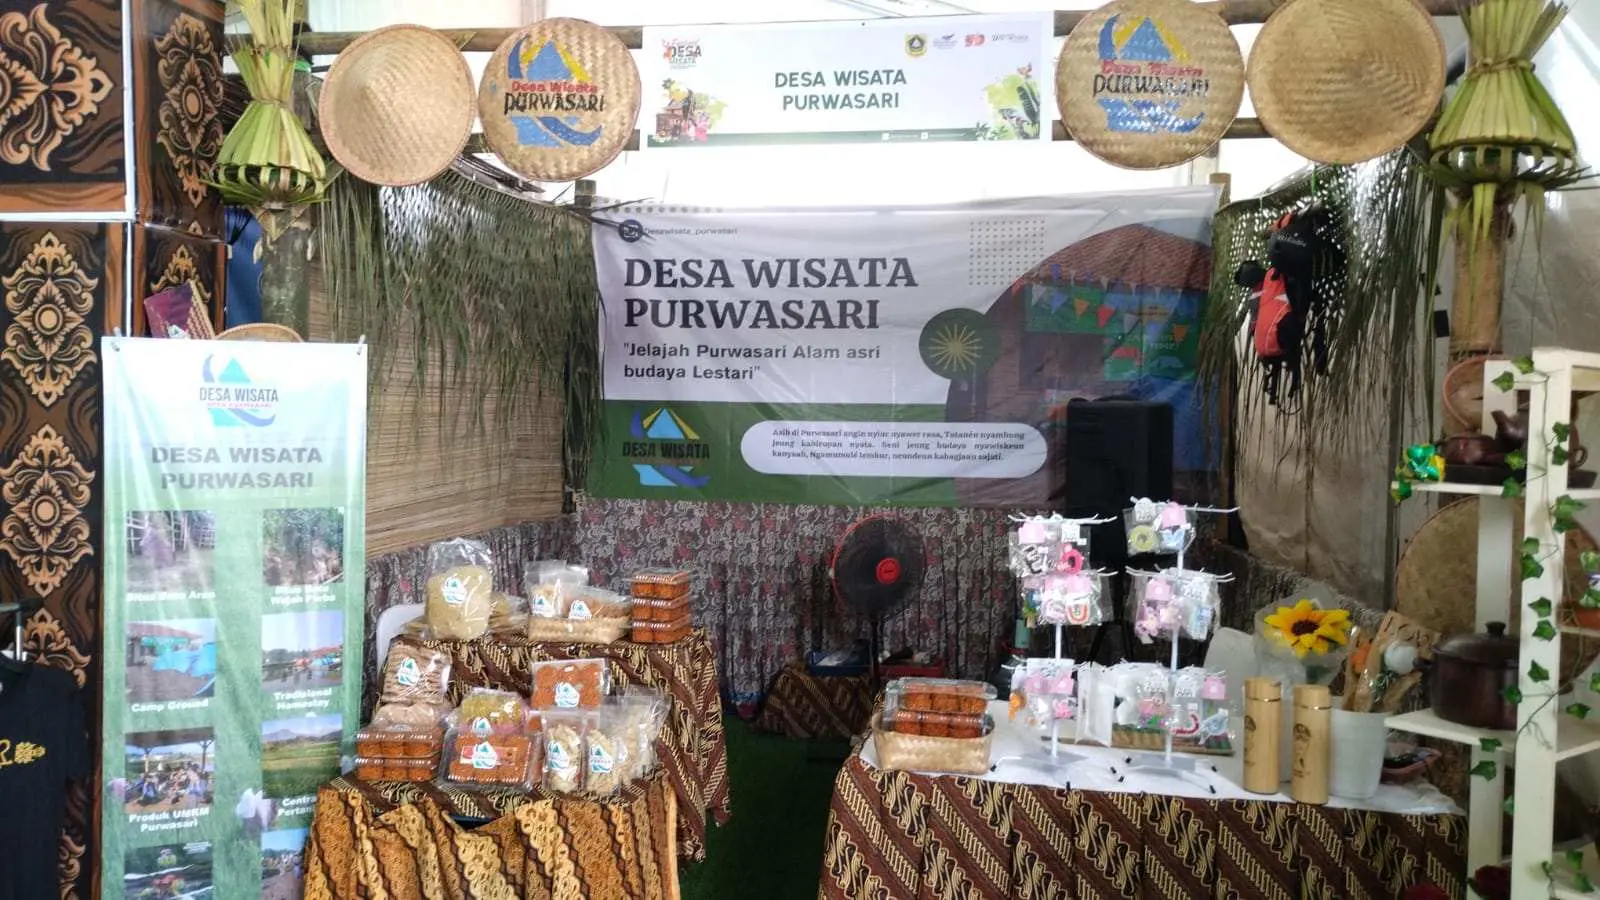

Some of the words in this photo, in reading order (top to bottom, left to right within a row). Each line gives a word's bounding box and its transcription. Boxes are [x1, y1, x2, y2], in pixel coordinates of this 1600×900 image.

[512, 80, 545, 93] Desa
[550, 81, 599, 93] Wisata
[774, 71, 827, 88] DESA
[833, 69, 908, 87] WISATA
[503, 92, 606, 115] PURWASARI
[783, 92, 900, 111] PURWASARI
[623, 257, 735, 289] DESA
[741, 257, 919, 288] WISATA
[623, 298, 881, 329] PURWASARI
[623, 342, 690, 360] "Jelajah
[697, 344, 787, 359] Purwasari
[792, 344, 840, 359] Alam
[846, 345, 881, 359] asri
[623, 364, 687, 380] budaya
[692, 364, 761, 380] Lestari"
[199, 387, 231, 401] DESA
[234, 388, 279, 402] WISATA
[151, 446, 221, 464] DESA
[229, 446, 323, 463] WISATA
[622, 440, 656, 457] DESA
[660, 441, 710, 459] WISATA
[161, 472, 314, 490] PURWASARI
[273, 688, 332, 700] Tradisional
[131, 702, 165, 713] Camp
[167, 699, 209, 710] Ground
[275, 699, 331, 710] Homestay
[128, 811, 170, 823] Produk
[172, 807, 210, 819] UMKM
[140, 818, 198, 832] Purwasari
